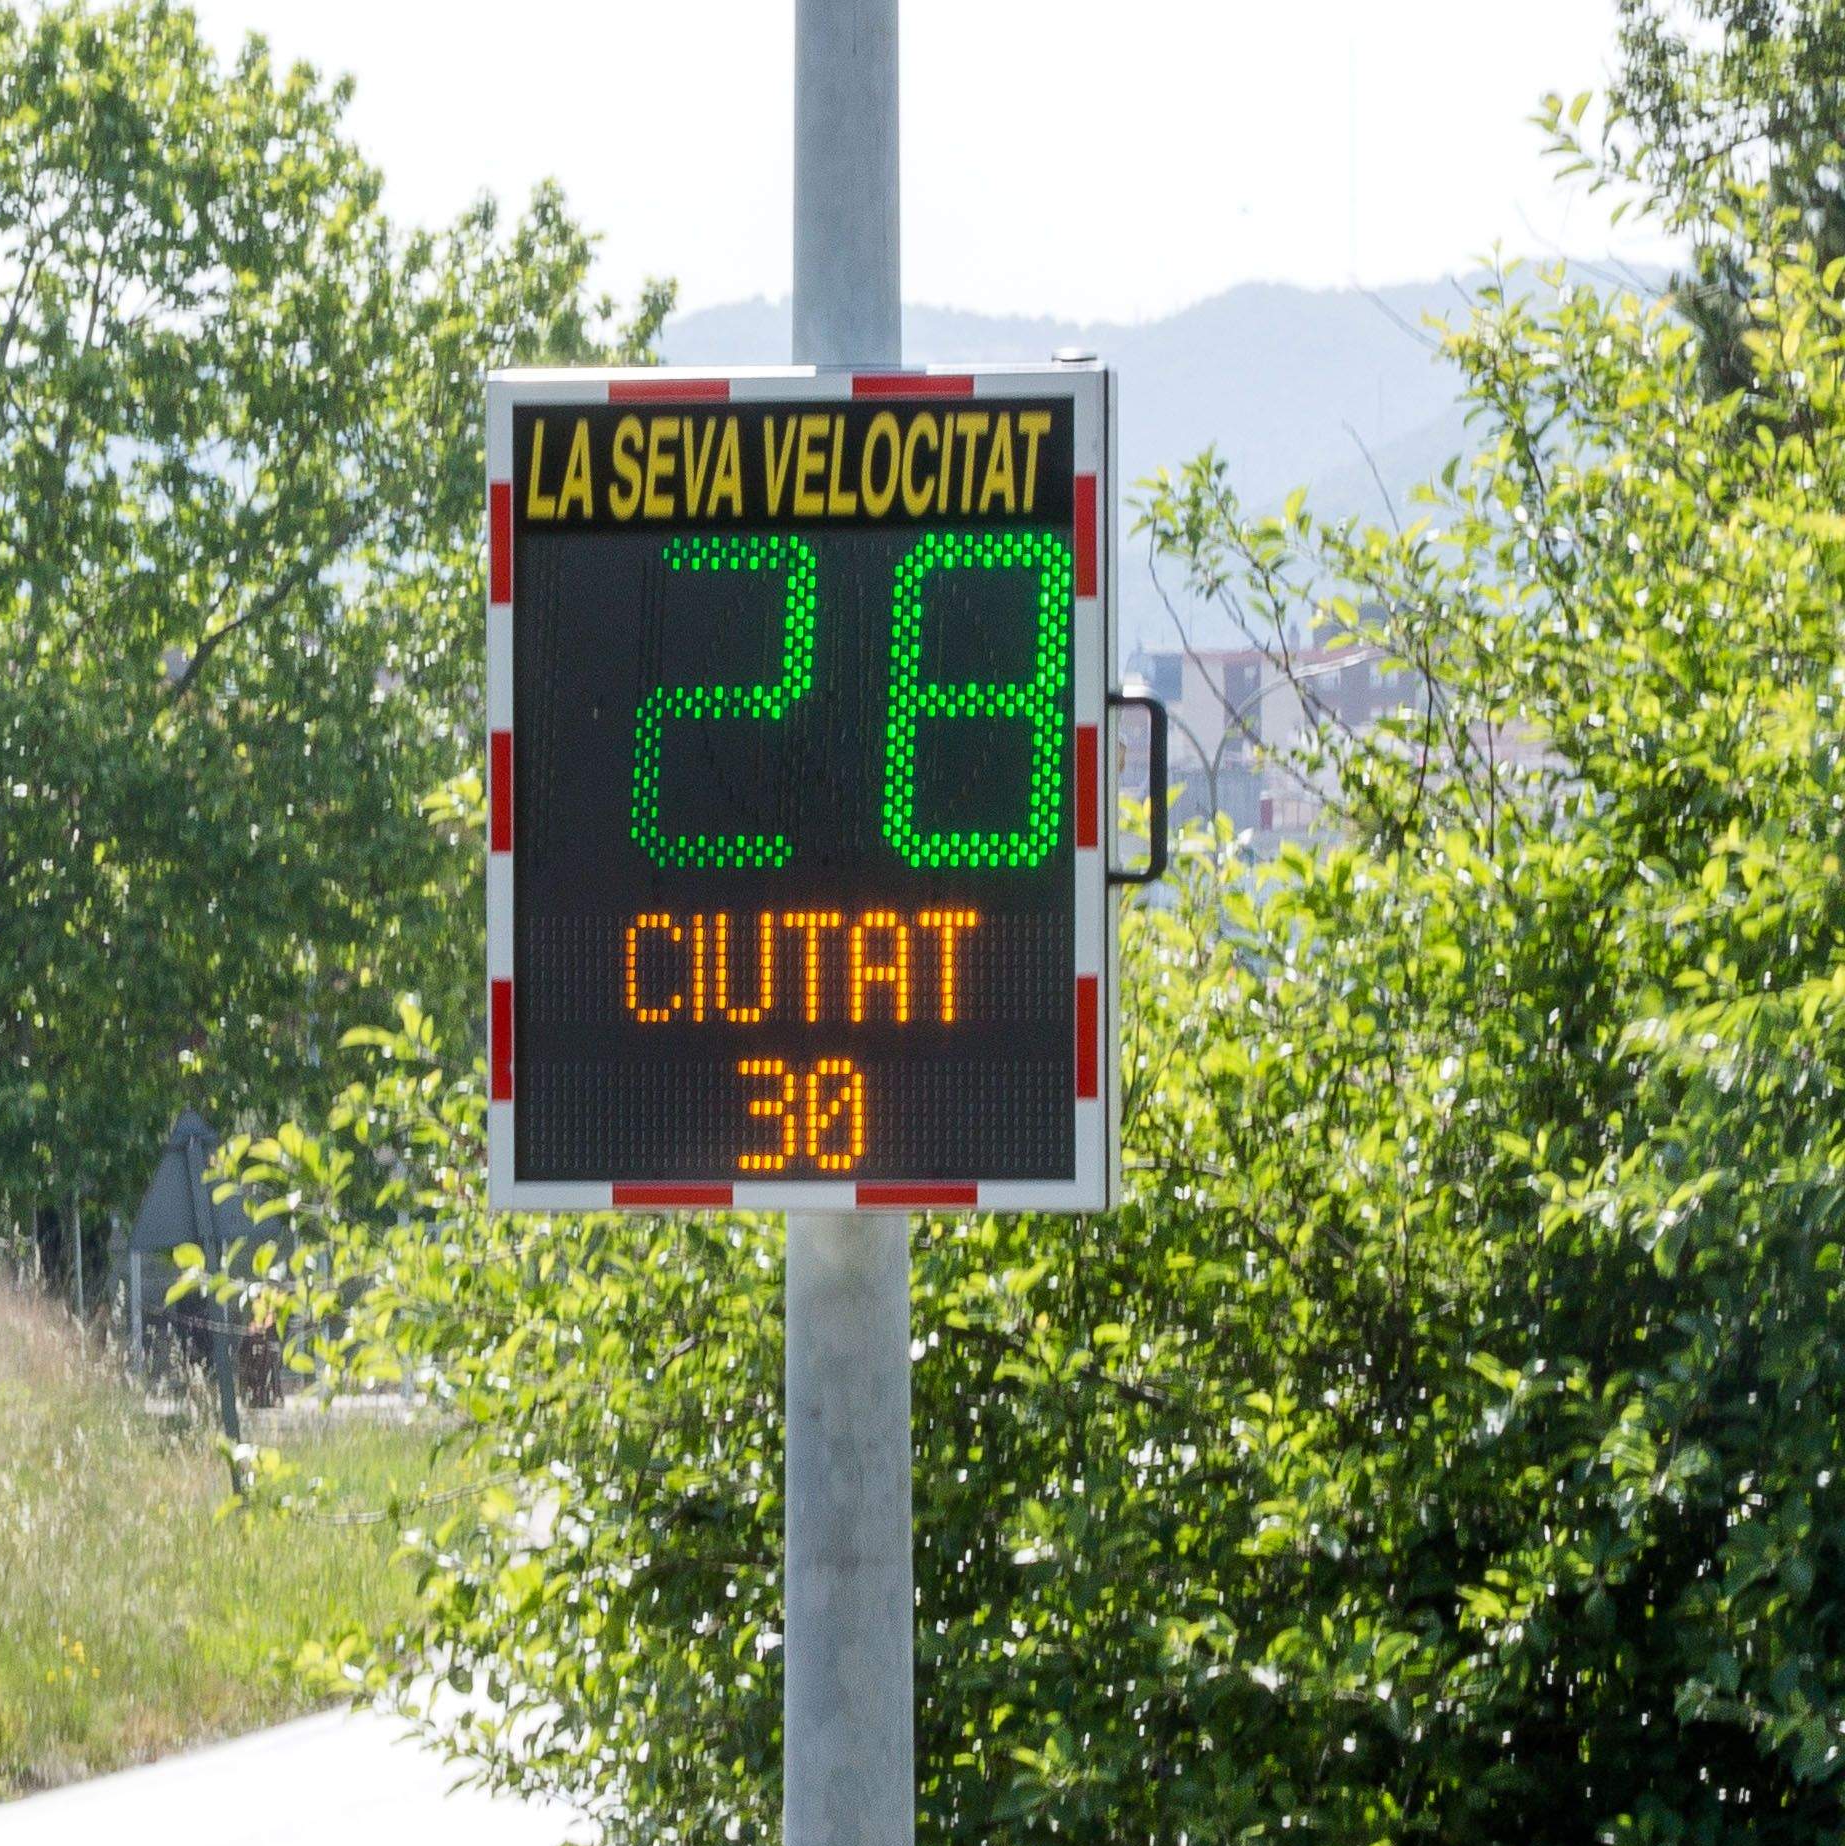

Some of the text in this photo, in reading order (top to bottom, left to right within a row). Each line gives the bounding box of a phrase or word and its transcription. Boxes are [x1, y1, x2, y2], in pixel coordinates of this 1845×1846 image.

[526, 410, 1052, 521] LA SEVA VELOCITAT
[630, 533, 1072, 868] 28
[625, 911, 979, 1024] CIUTAT
[736, 1058, 867, 1171] 30
